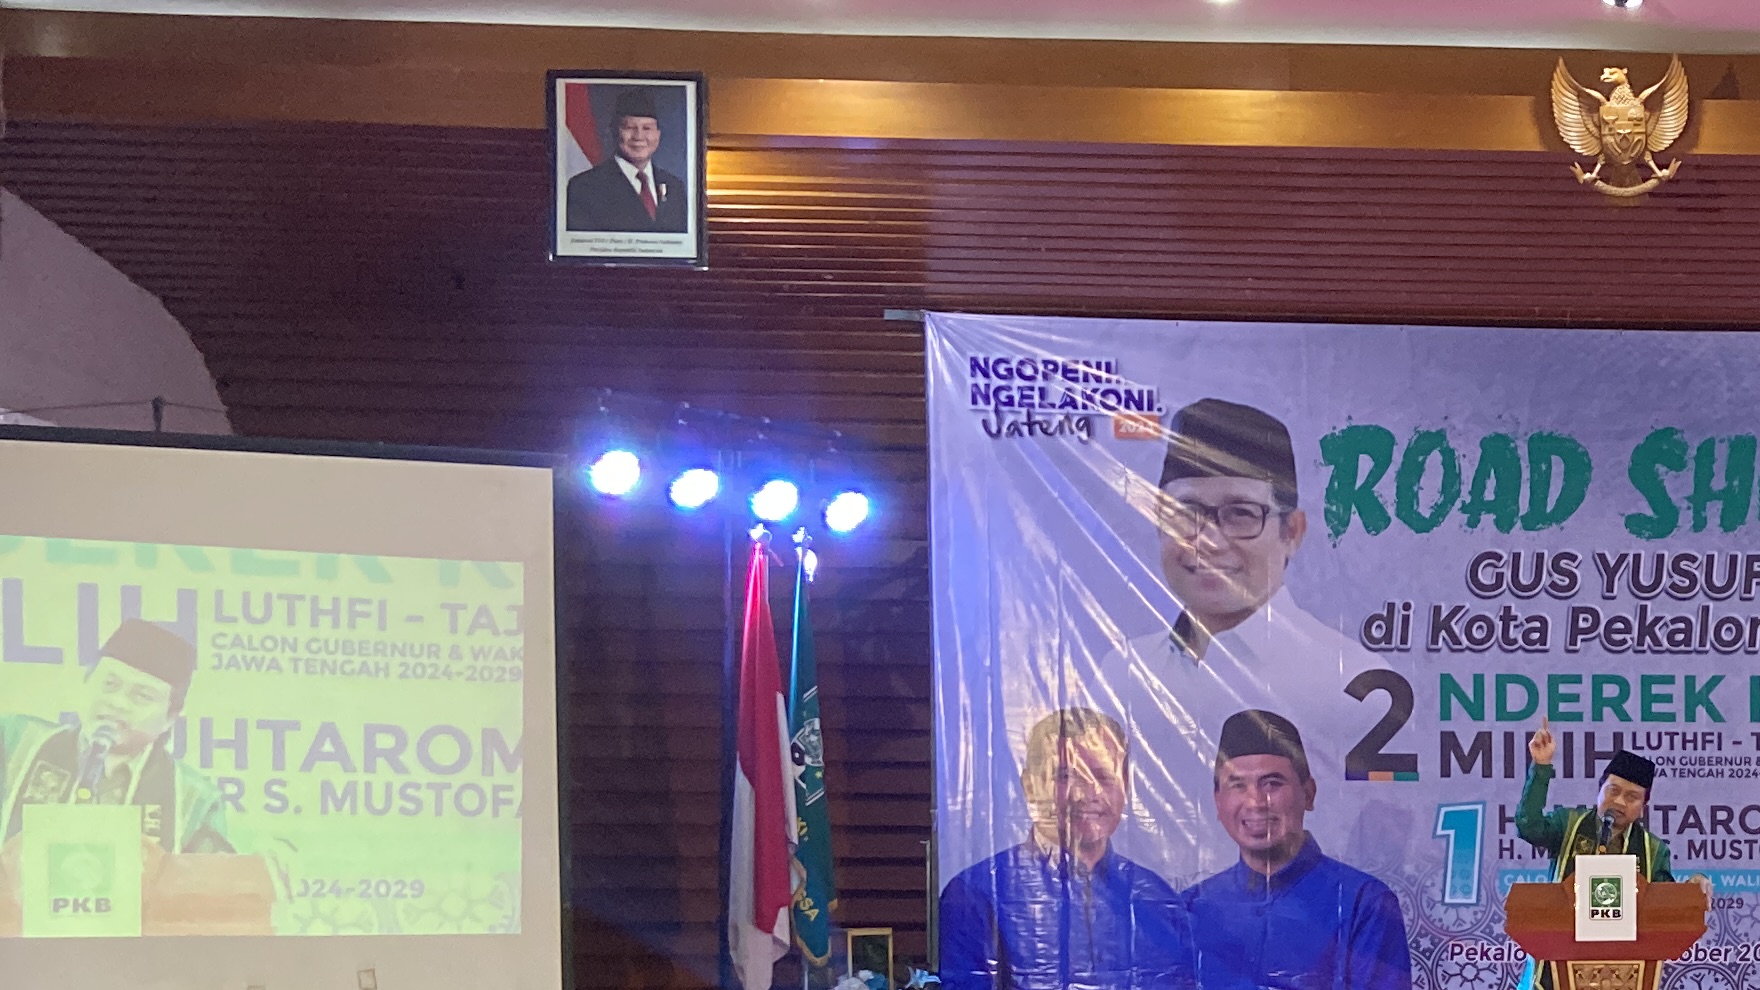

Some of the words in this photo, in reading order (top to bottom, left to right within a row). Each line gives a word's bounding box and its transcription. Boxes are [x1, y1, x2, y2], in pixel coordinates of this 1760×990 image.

[971, 383, 1163, 412] NGELAKONI.
[982, 402, 1091, 444] Jateng
[1320, 424, 1593, 541] ROAD
[1468, 550, 1582, 597] GUS
[214, 589, 387, 631] LUTHFI
[1363, 603, 1413, 649] di
[1429, 604, 1550, 649] Kota
[211, 632, 298, 653] CALON
[305, 637, 441, 660] GUBERNUR
[448, 644, 464, 661] &
[470, 646, 523, 662] WAK
[211, 653, 283, 673] JAWA
[290, 657, 390, 679] TENGAH
[398, 662, 523, 682] 2024-2029
[1440, 673, 1726, 723] NDEREK
[1344, 669, 1418, 773] 2
[1440, 730, 1624, 778] MIIH
[1632, 731, 1723, 751] LUTHFI
[1672, 768, 1724, 778] TENGAH
[1680, 756, 1752, 767] GUBERNUR
[264, 778, 303, 814] S.
[320, 780, 522, 819] MUSTOF
[1432, 801, 1486, 905] 1
[1499, 839, 1522, 859] H.
[52, 897, 112, 913] PKB
[1591, 909, 1621, 918] PKB
[1711, 898, 1744, 909] 2029
[1450, 943, 1527, 962] Pekalo
[1680, 943, 1732, 961] ober
